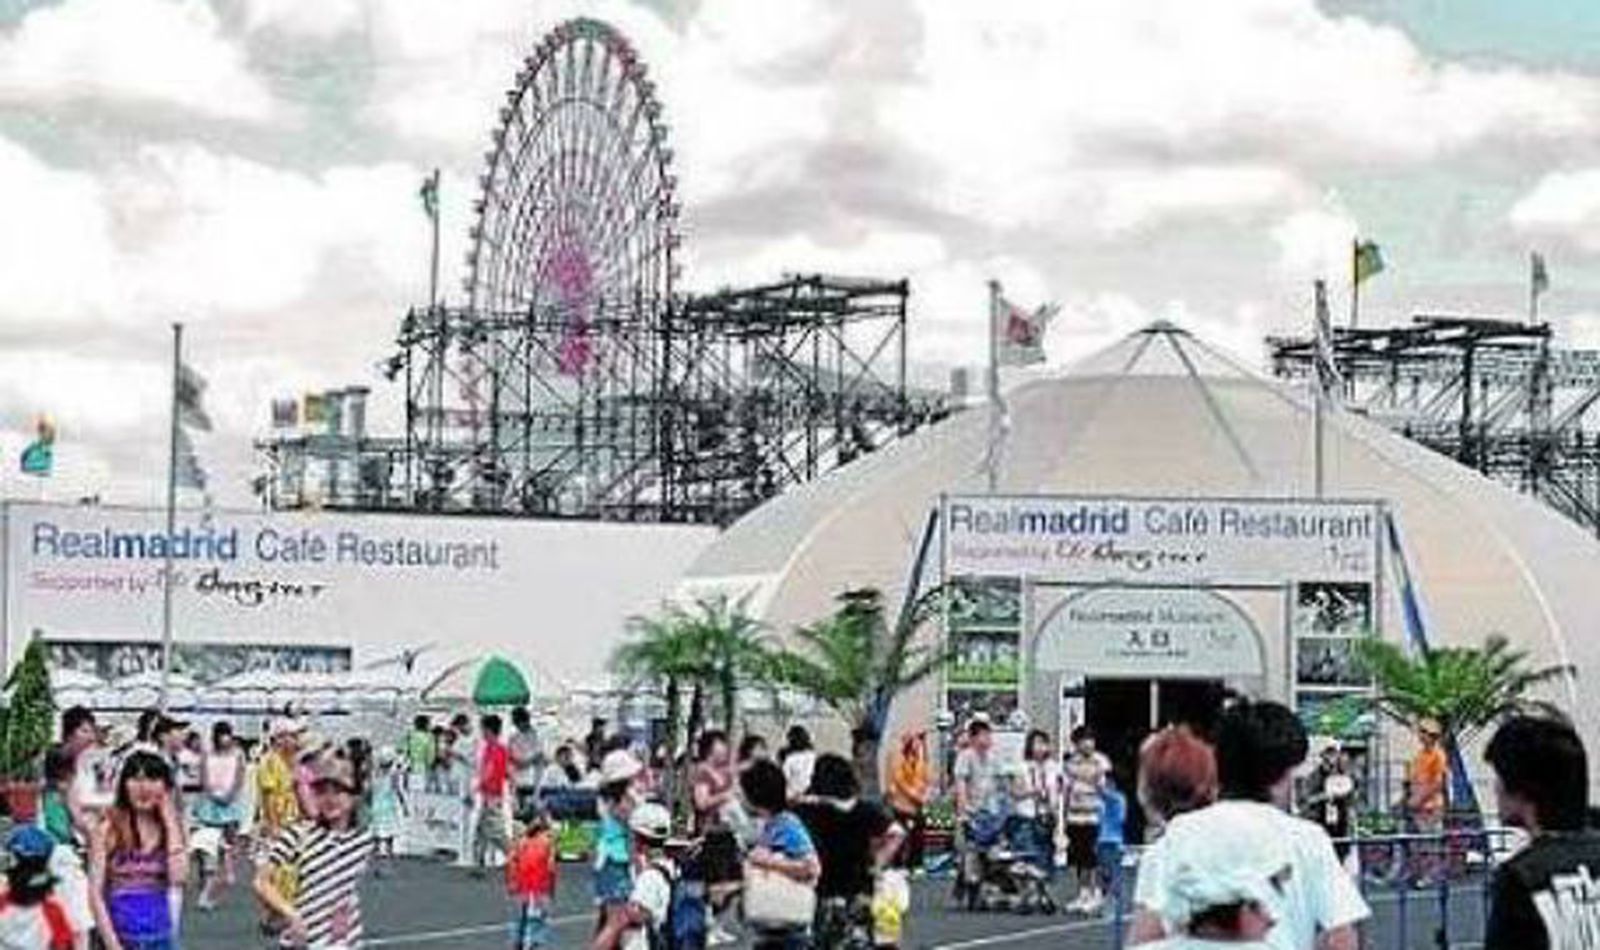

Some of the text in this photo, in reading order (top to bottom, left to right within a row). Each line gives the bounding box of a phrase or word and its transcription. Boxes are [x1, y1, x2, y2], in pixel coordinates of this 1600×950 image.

[949, 505, 1129, 534] Realmadrid
[1220, 507, 1371, 538] Restaurant
[32, 521, 237, 559] Realmadrid
[337, 532, 499, 569] Restaurant
